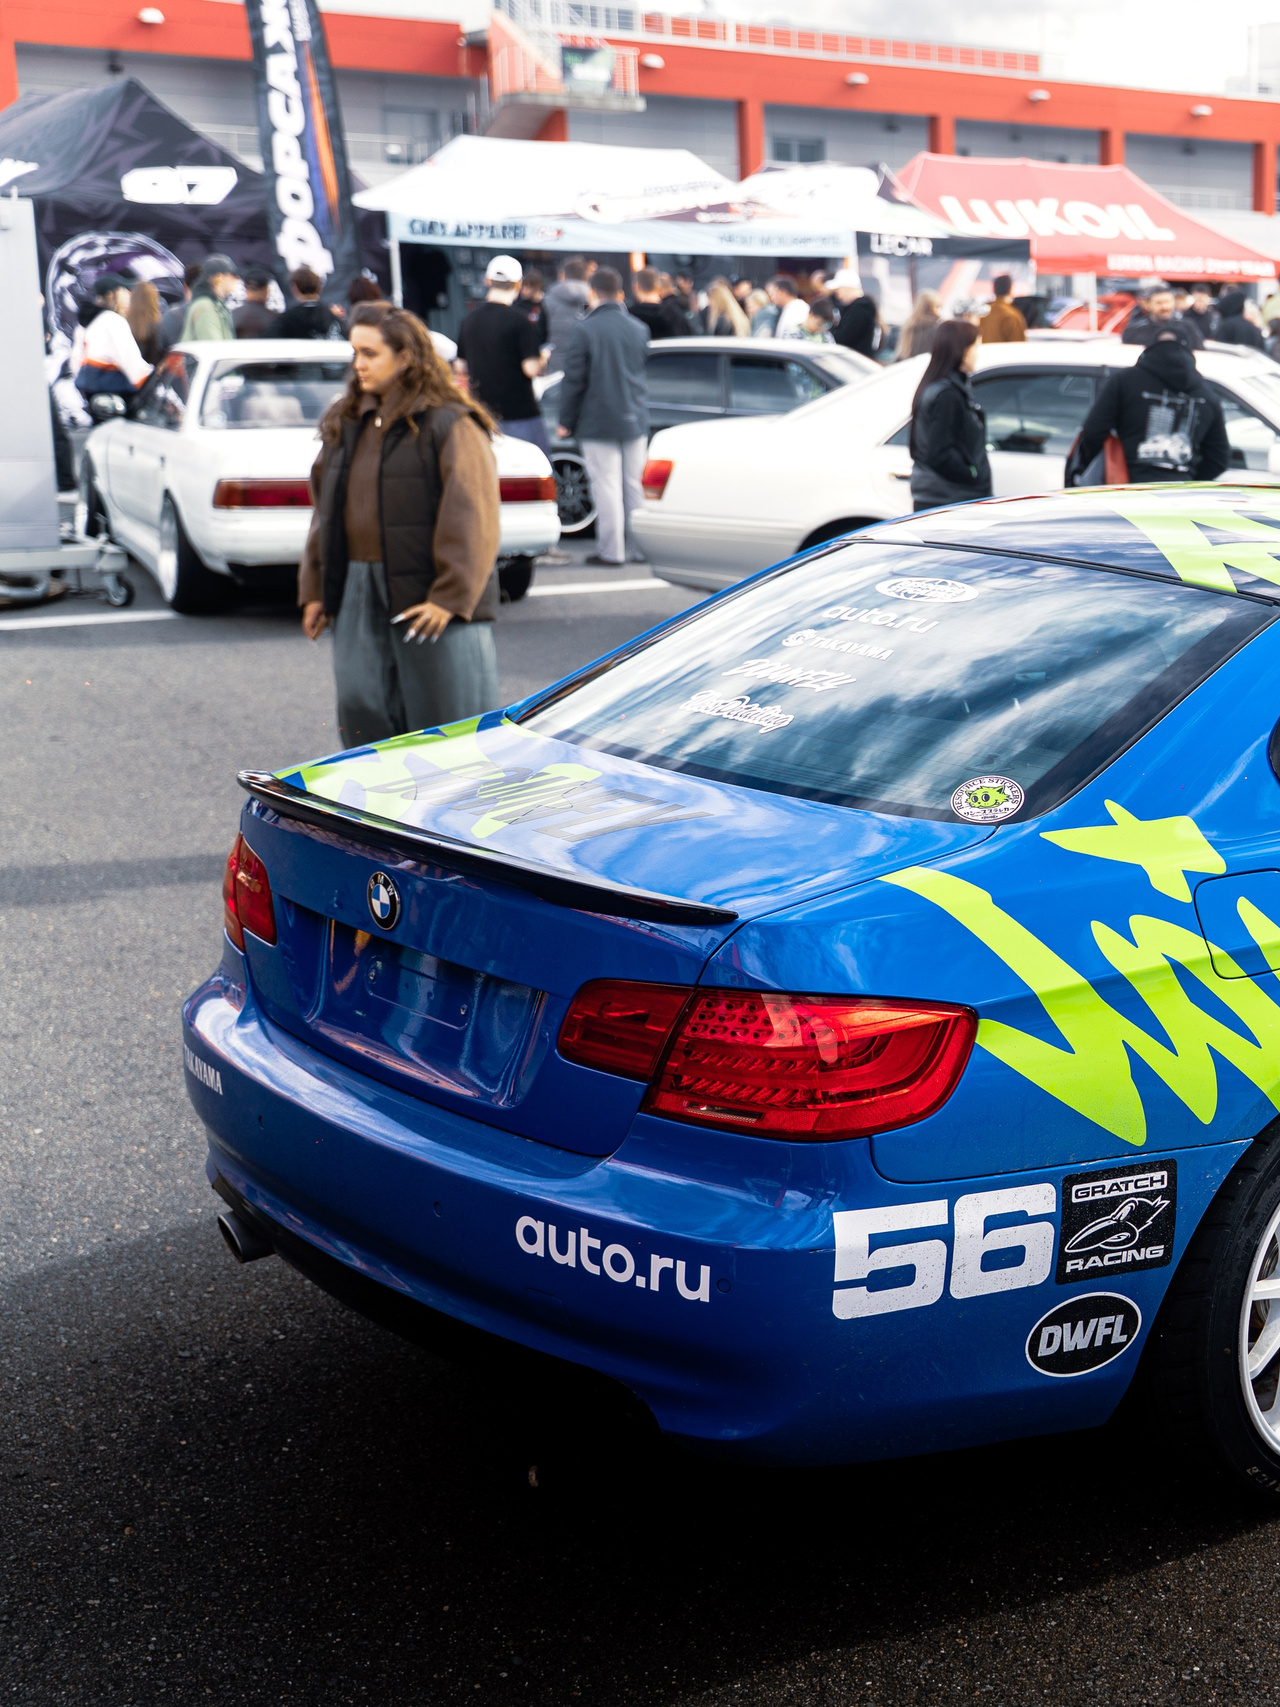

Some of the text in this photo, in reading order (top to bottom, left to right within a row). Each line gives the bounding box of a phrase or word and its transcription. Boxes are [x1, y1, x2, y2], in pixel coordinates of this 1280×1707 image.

[938, 196, 1177, 241] LUKOIL
[821, 605, 940, 634] auto.ru
[808, 636, 895, 661] TAKAYAMA
[1074, 1173, 1166, 1200] GRATCH
[515, 1214, 712, 1303] auto.ru
[832, 1182, 1058, 1321] 56
[1065, 1244, 1165, 1273] RACING
[1037, 1313, 1129, 1358] DWFL
